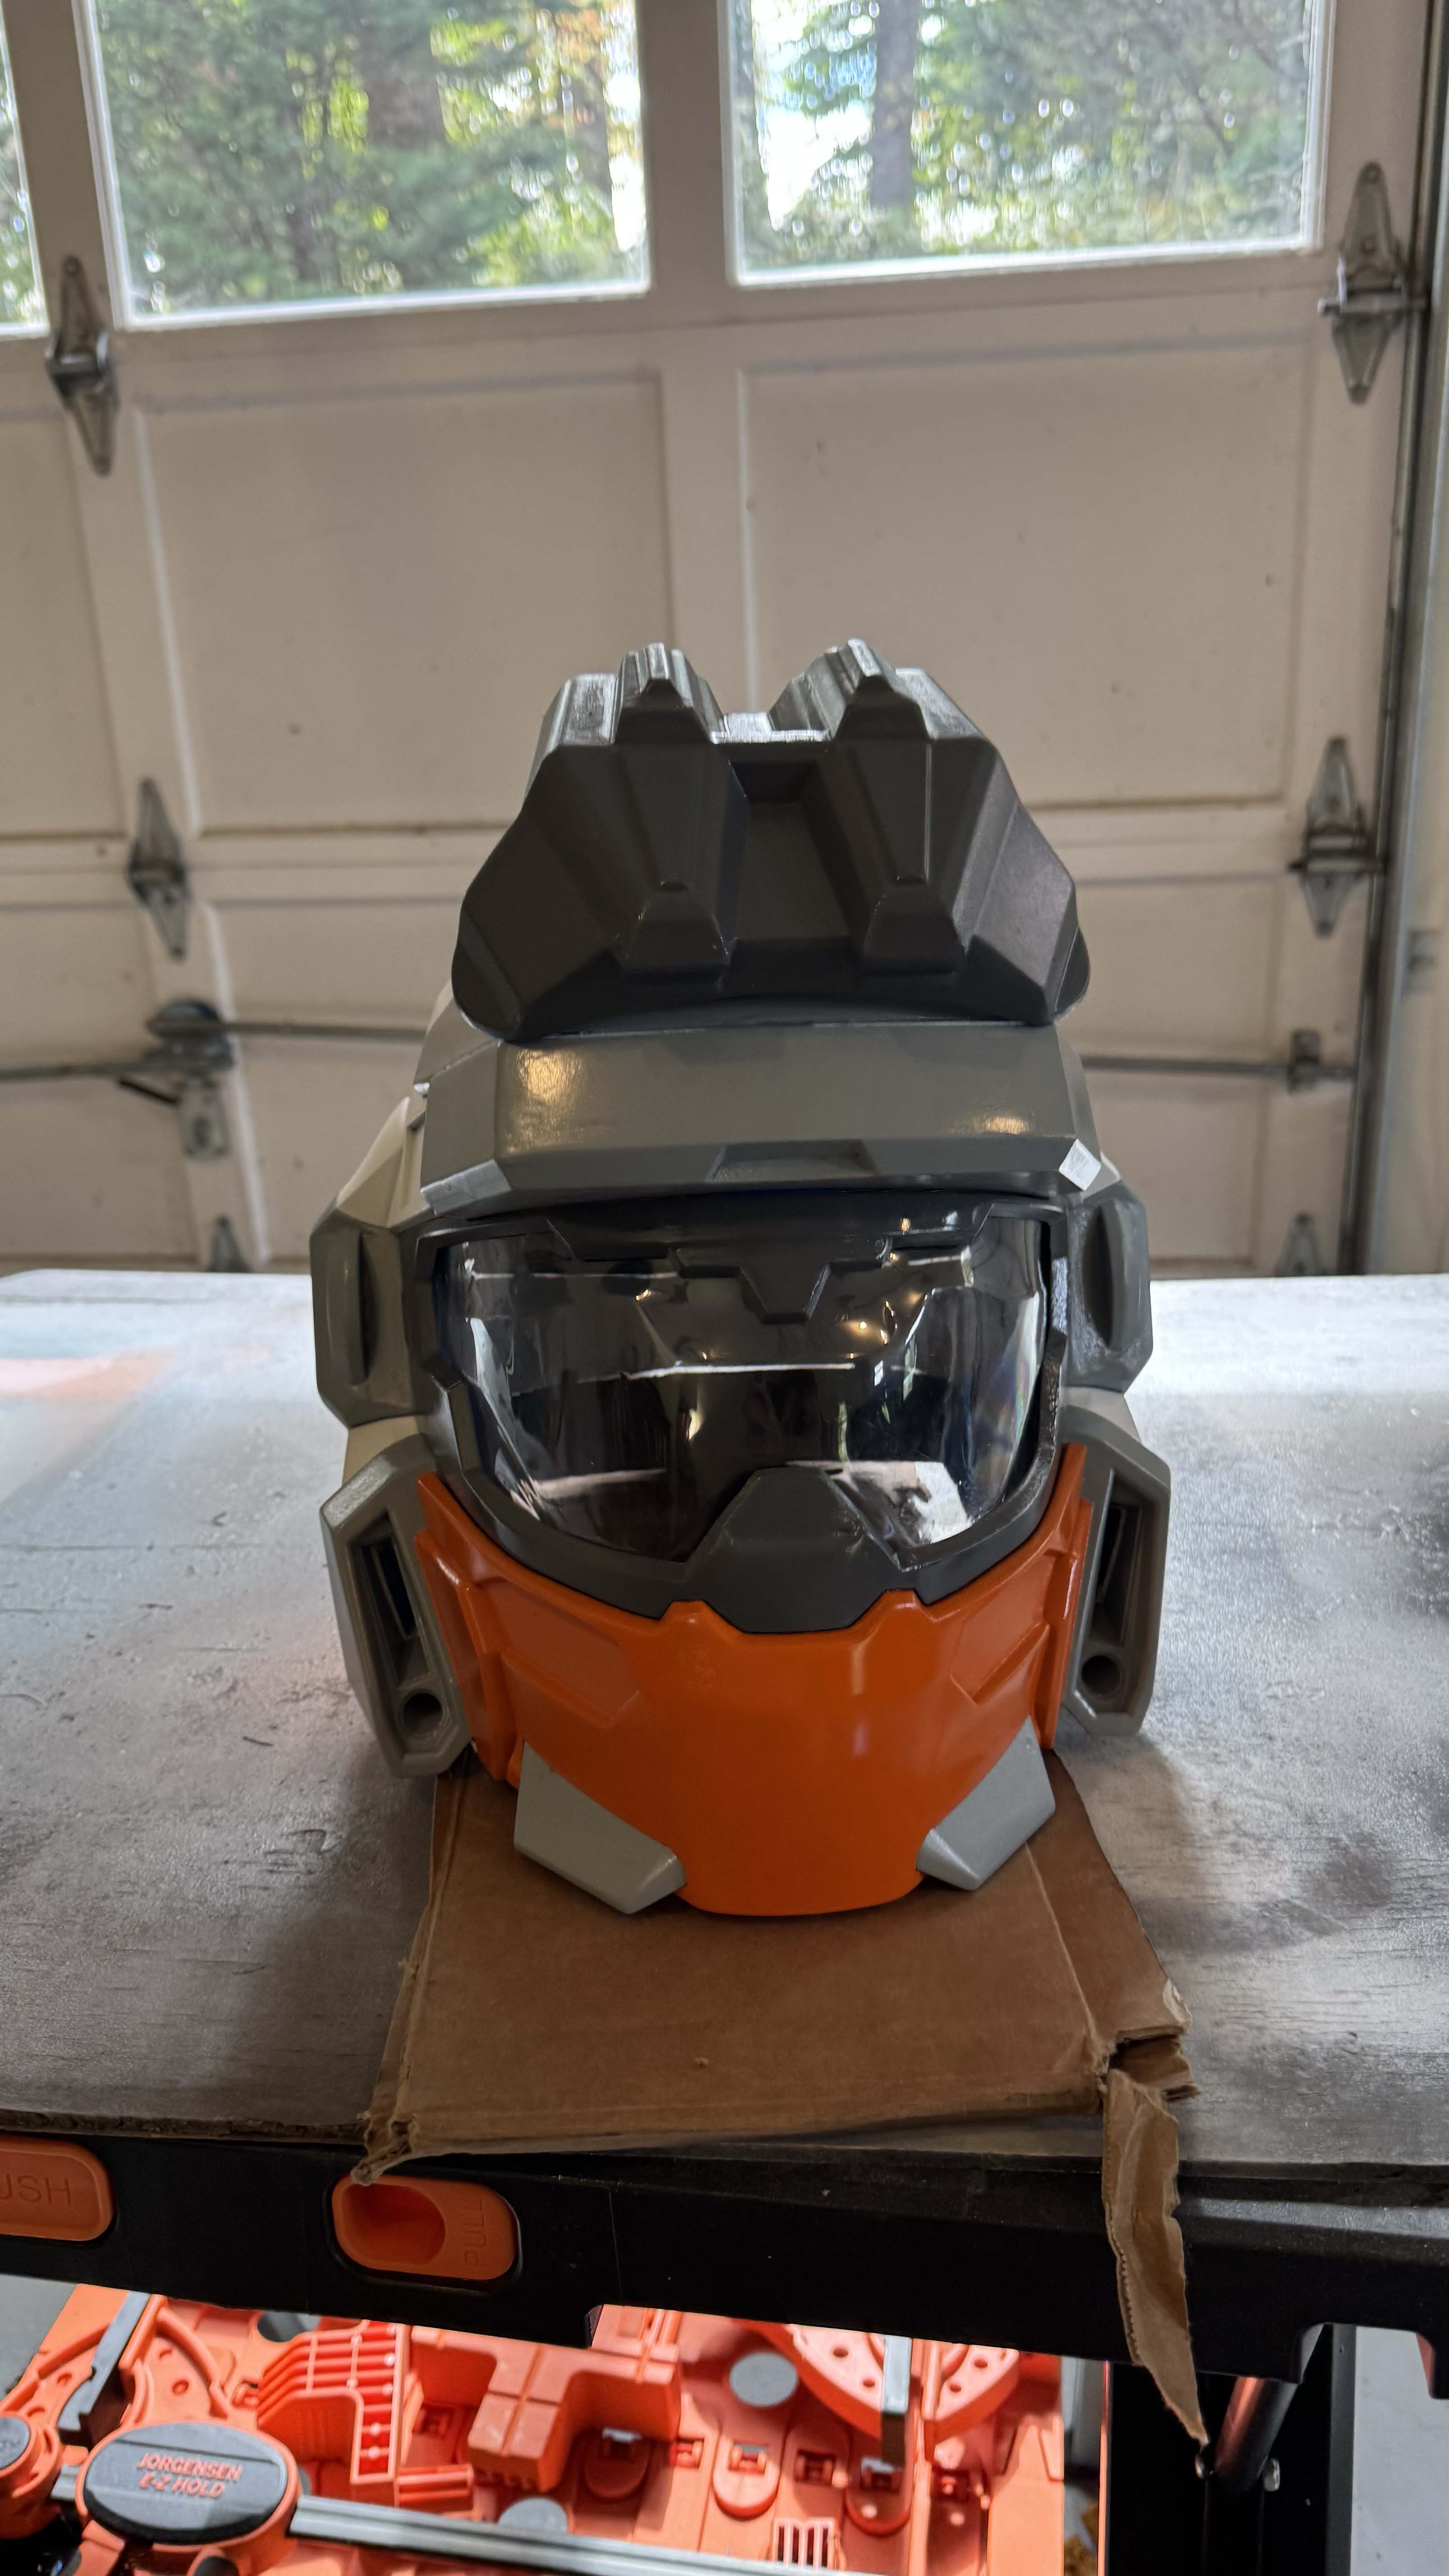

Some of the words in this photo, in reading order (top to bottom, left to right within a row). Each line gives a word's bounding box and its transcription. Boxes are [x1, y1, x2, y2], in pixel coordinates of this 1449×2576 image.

[461, 2197, 491, 2267] PULL
[137, 2453, 243, 2481] JORGENSEN
[171, 2476, 225, 2498] HOLD
